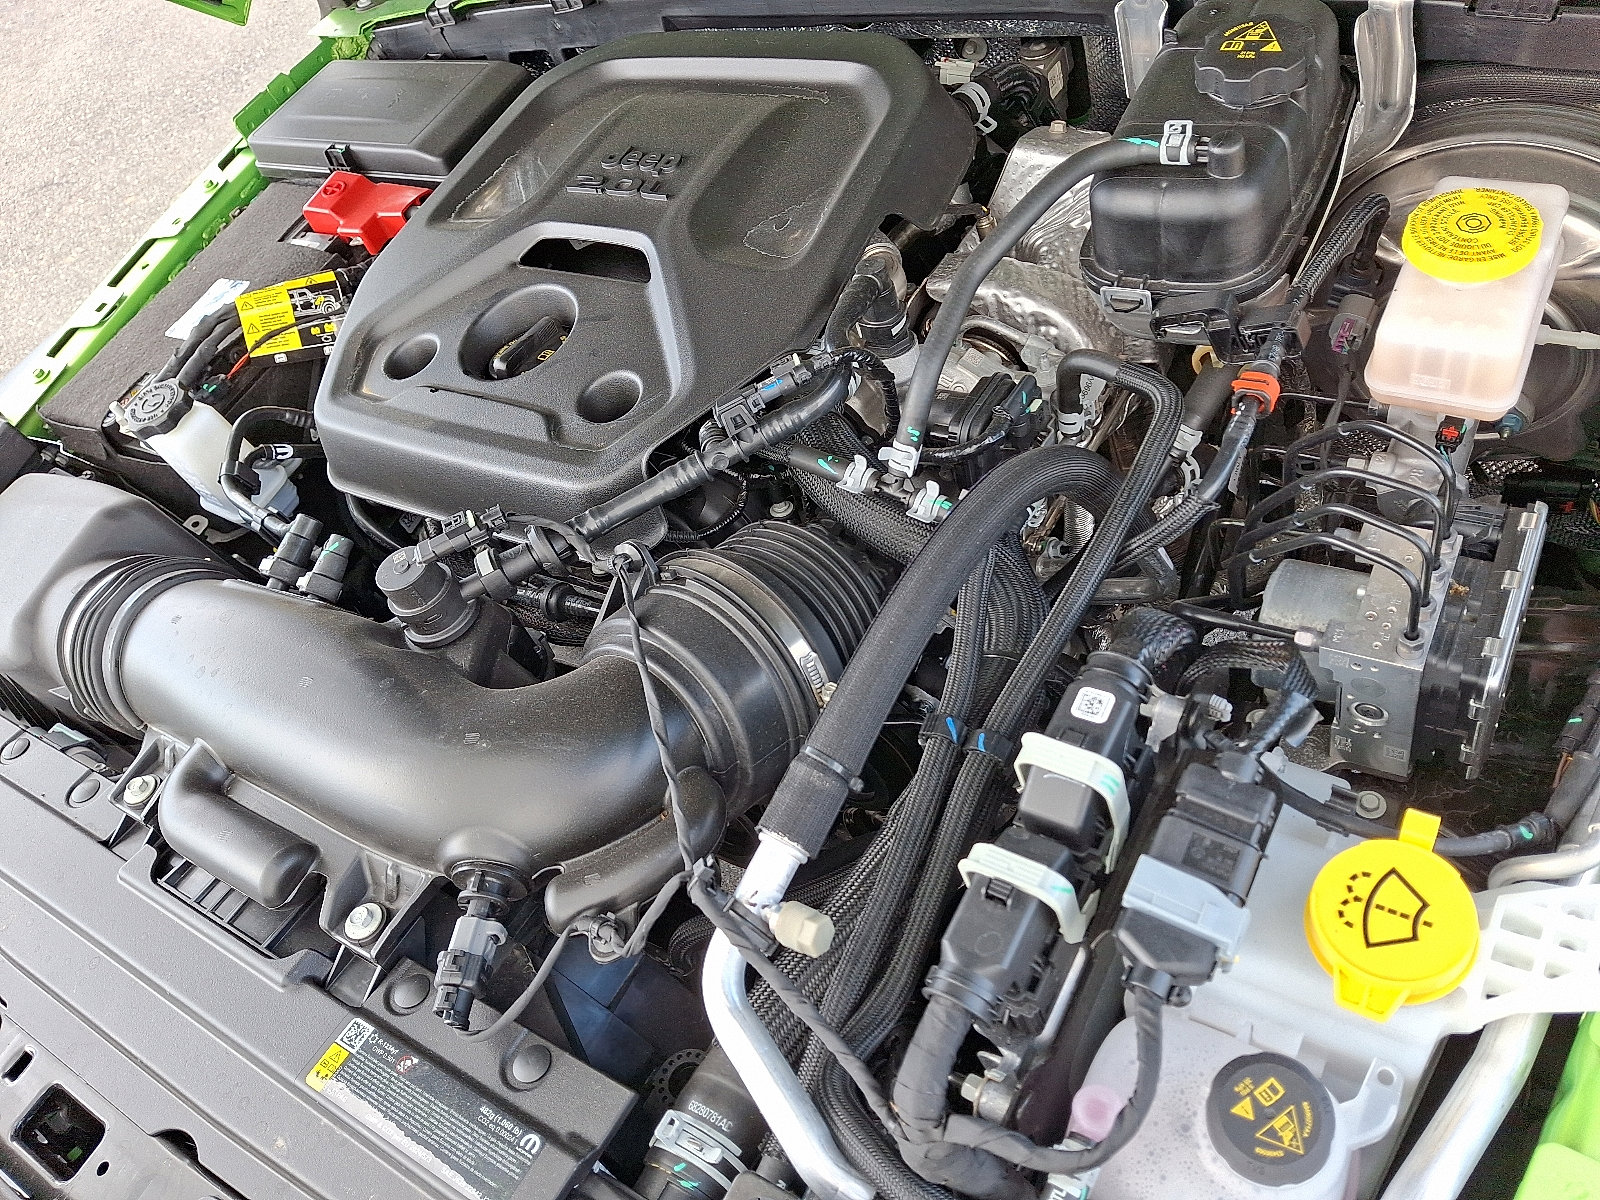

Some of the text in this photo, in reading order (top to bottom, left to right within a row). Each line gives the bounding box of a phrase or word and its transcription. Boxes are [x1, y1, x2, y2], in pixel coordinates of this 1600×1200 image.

[1448, 241, 1479, 249] LIQUIDE
[1471, 248, 1497, 256] AVANT
[1487, 252, 1507, 260] MISE
[478, 1105, 495, 1119] 482g
